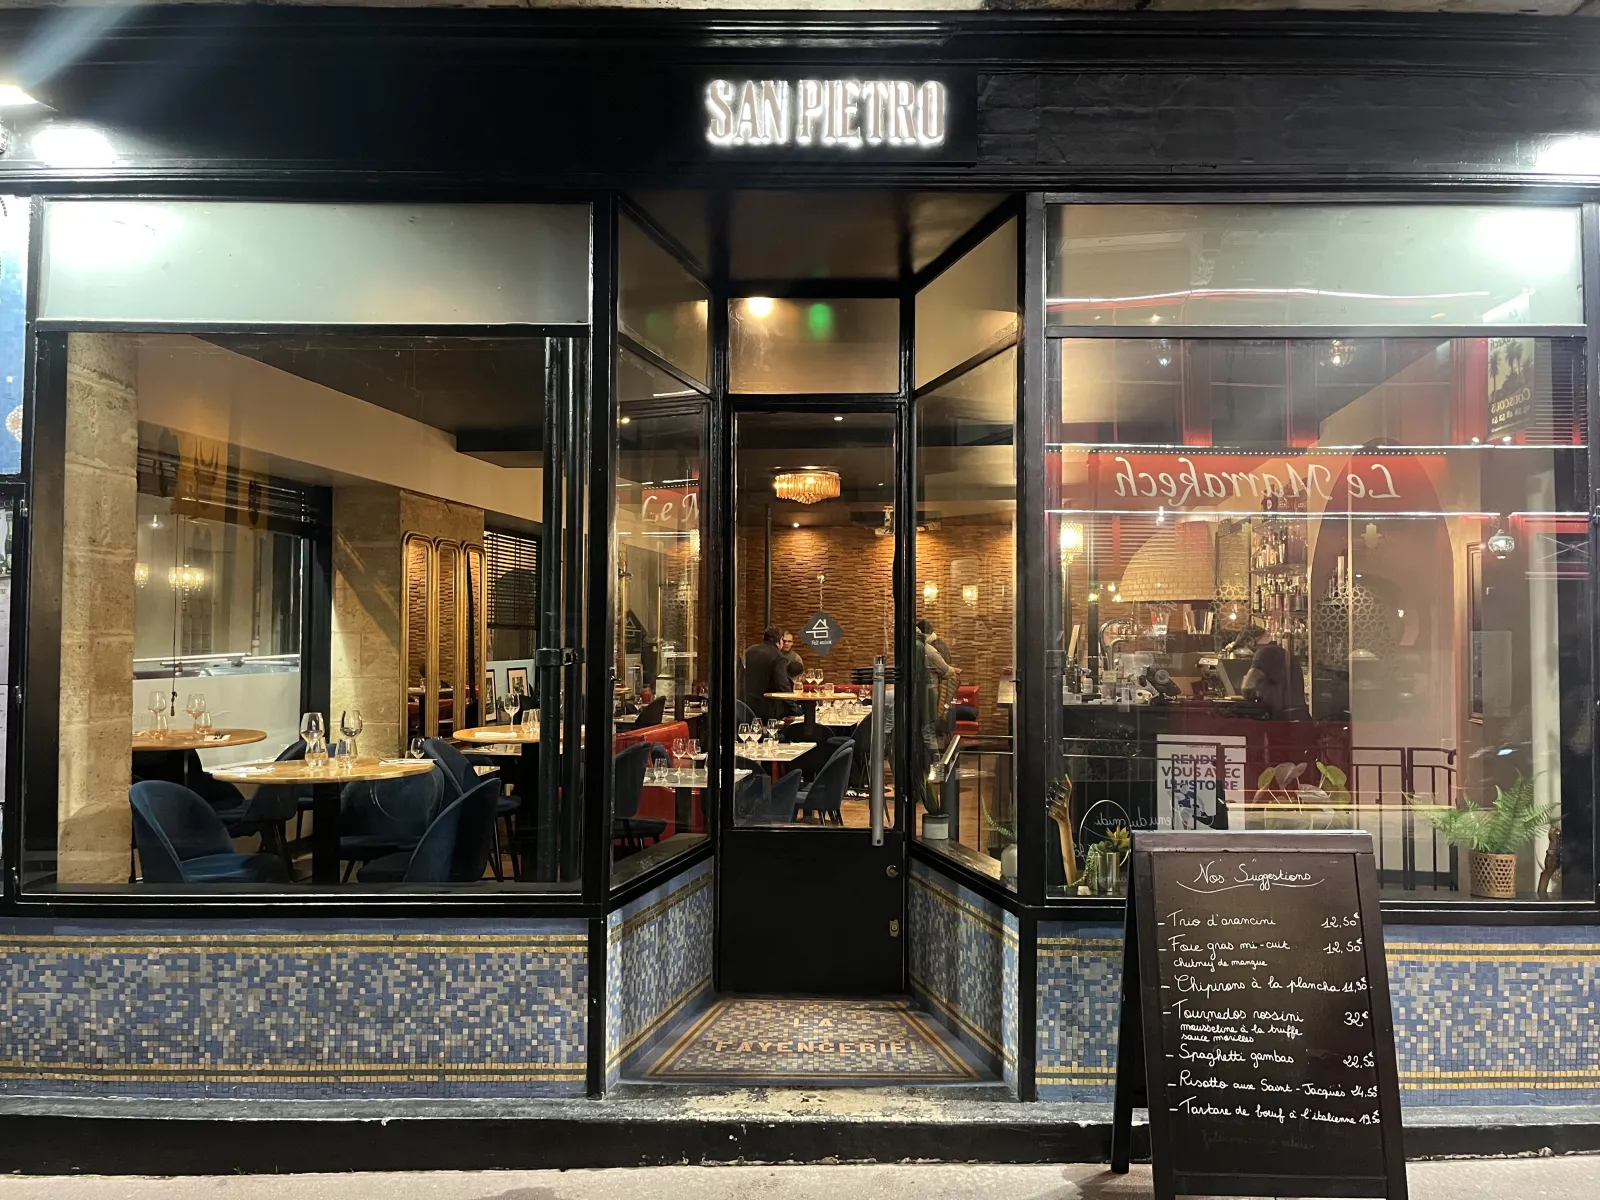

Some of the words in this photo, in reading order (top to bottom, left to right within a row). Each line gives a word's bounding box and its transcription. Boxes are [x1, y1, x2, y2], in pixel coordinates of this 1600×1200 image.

[709, 79, 789, 141] SAN
[799, 79, 945, 141] PIETRO
[642, 495, 674, 523] Le
[1172, 754, 1232, 765] RENDE-
[1161, 766, 1202, 778] VOUS
[1193, 860, 1225, 885] Nos
[1233, 863, 1312, 891] Suggestions
[1167, 909, 1201, 927] Trio
[1207, 913, 1277, 927] d'arancini
[1167, 934, 1204, 953] Foie
[1207, 941, 1235, 961] gras
[1173, 957, 1215, 973] chutney
[1217, 959, 1229, 967] de
[1231, 959, 1269, 971] mangue
[1174, 974, 1246, 999] Chipirons
[1250, 977, 1263, 989] à
[1267, 976, 1284, 990] la
[1286, 976, 1340, 996] plancha
[1172, 999, 1248, 1021] Tournedos
[1252, 1009, 1304, 1023] rossini
[1343, 1010, 1369, 1027] 32€
[1180, 1023, 1238, 1034] mousseline
[1240, 1023, 1249, 1034] à
[1251, 1023, 1265, 1034] la
[1267, 1023, 1303, 1038] truffe
[1180, 1033, 1211, 1043] sauce
[1213, 1033, 1255, 1043] morilles
[715, 1041, 908, 1054] FAYENCERIE
[1179, 1043, 1247, 1067] Spaghetti
[1250, 1050, 1295, 1069] gambas
[1179, 1069, 1229, 1089] Risotto
[1232, 1081, 1256, 1091] aux
[1178, 1096, 1232, 1115] Tartare
[1235, 1106, 1250, 1116] de
[1289, 1108, 1298, 1119] à
[1300, 1107, 1357, 1124] l'italienne
